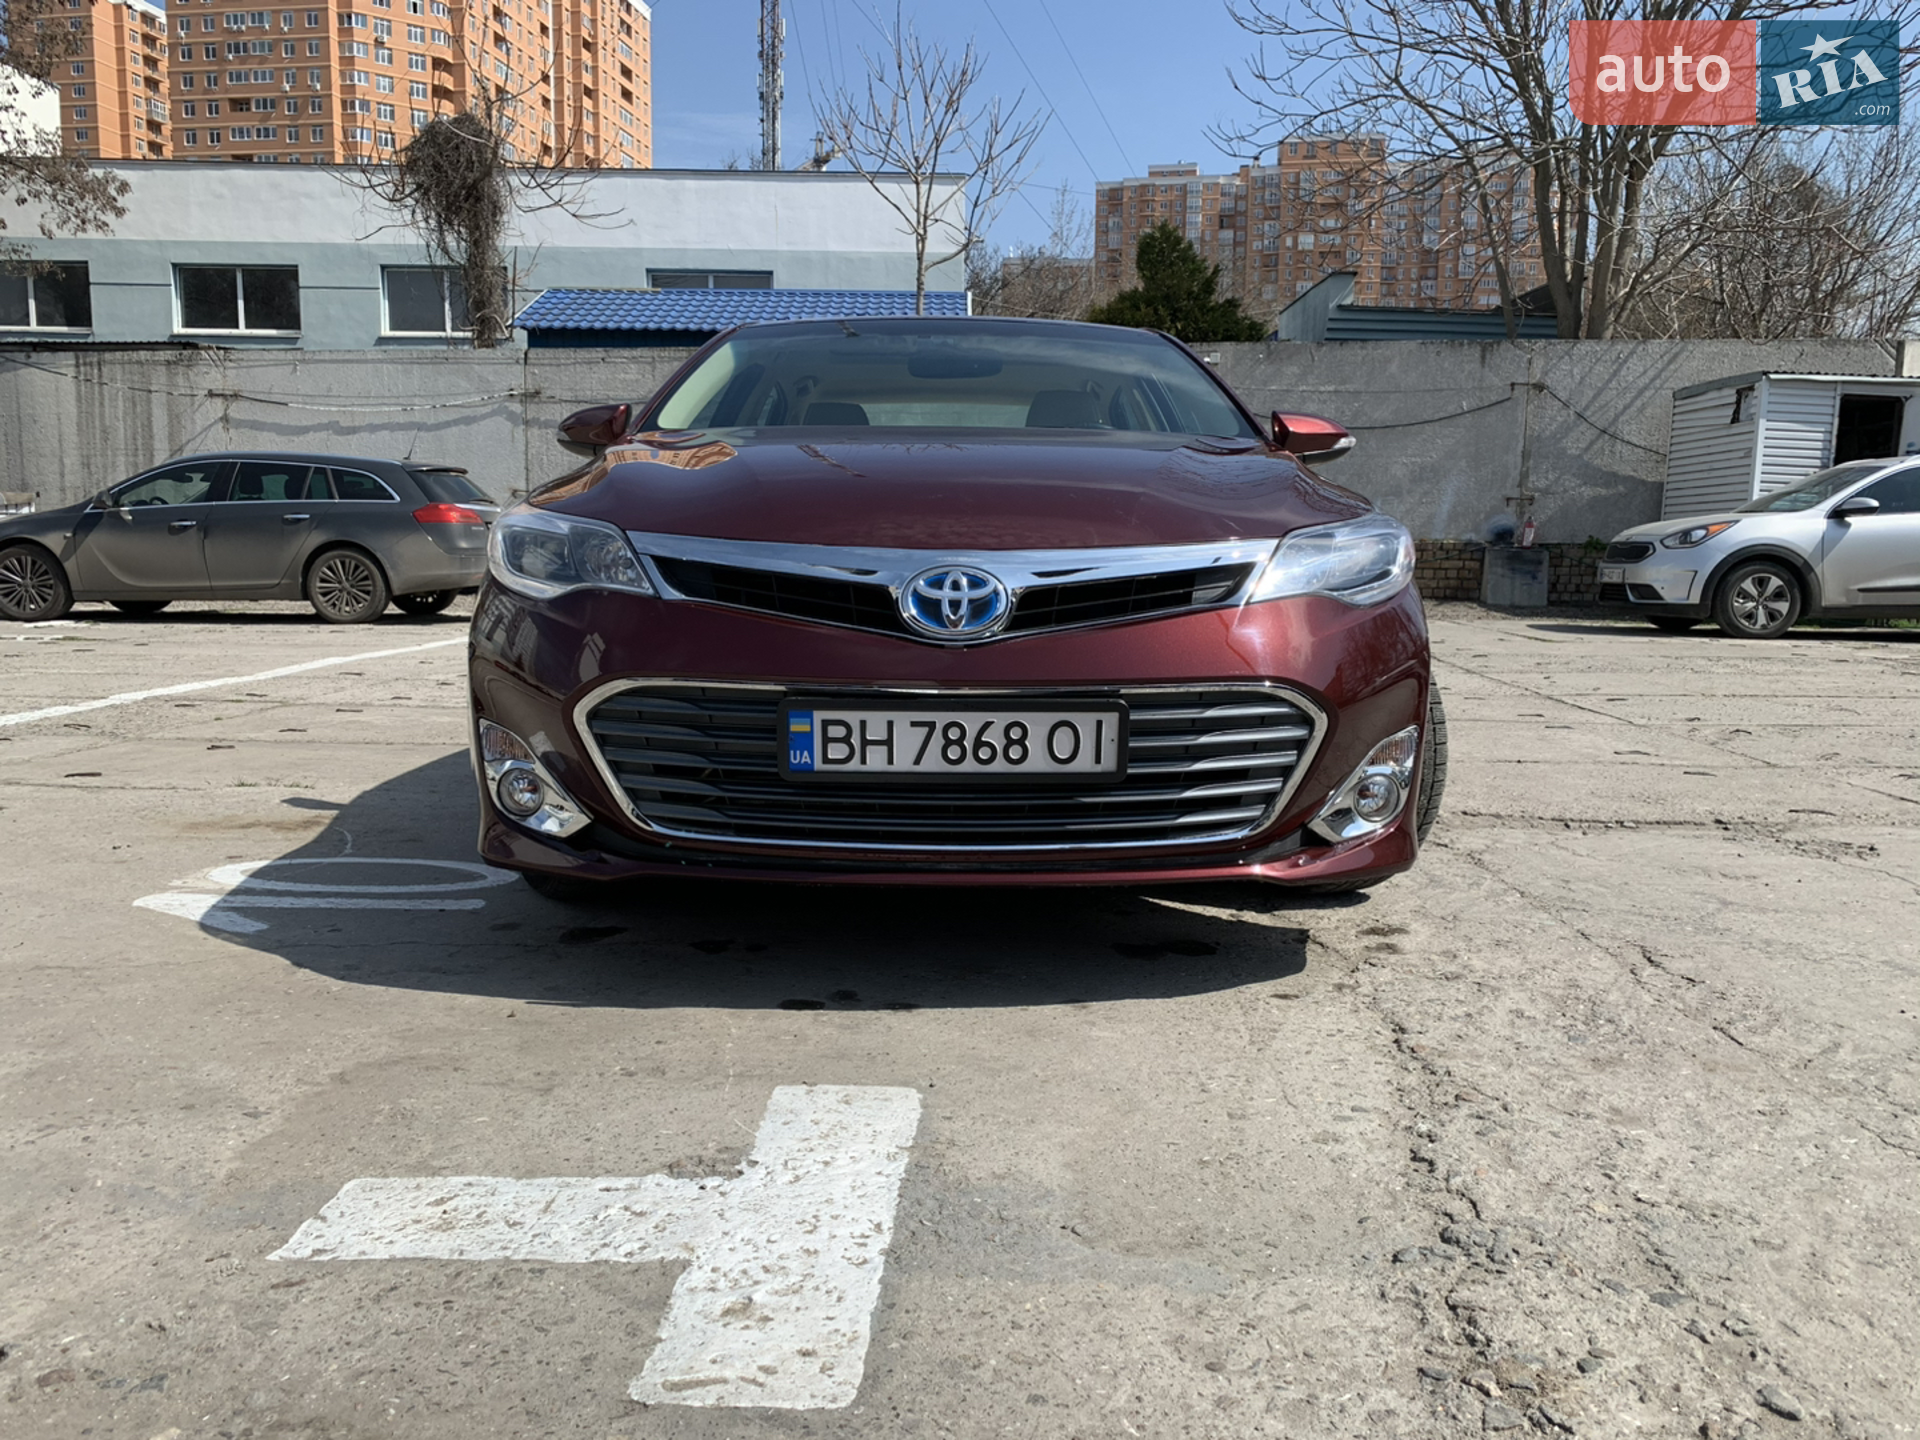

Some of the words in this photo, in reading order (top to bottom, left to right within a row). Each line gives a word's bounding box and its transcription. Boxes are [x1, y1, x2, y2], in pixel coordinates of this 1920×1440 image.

[790, 750, 812, 765] UA
[821, 718, 895, 766] BH
[909, 719, 1031, 767] 7868
[1047, 719, 1104, 766] OI
